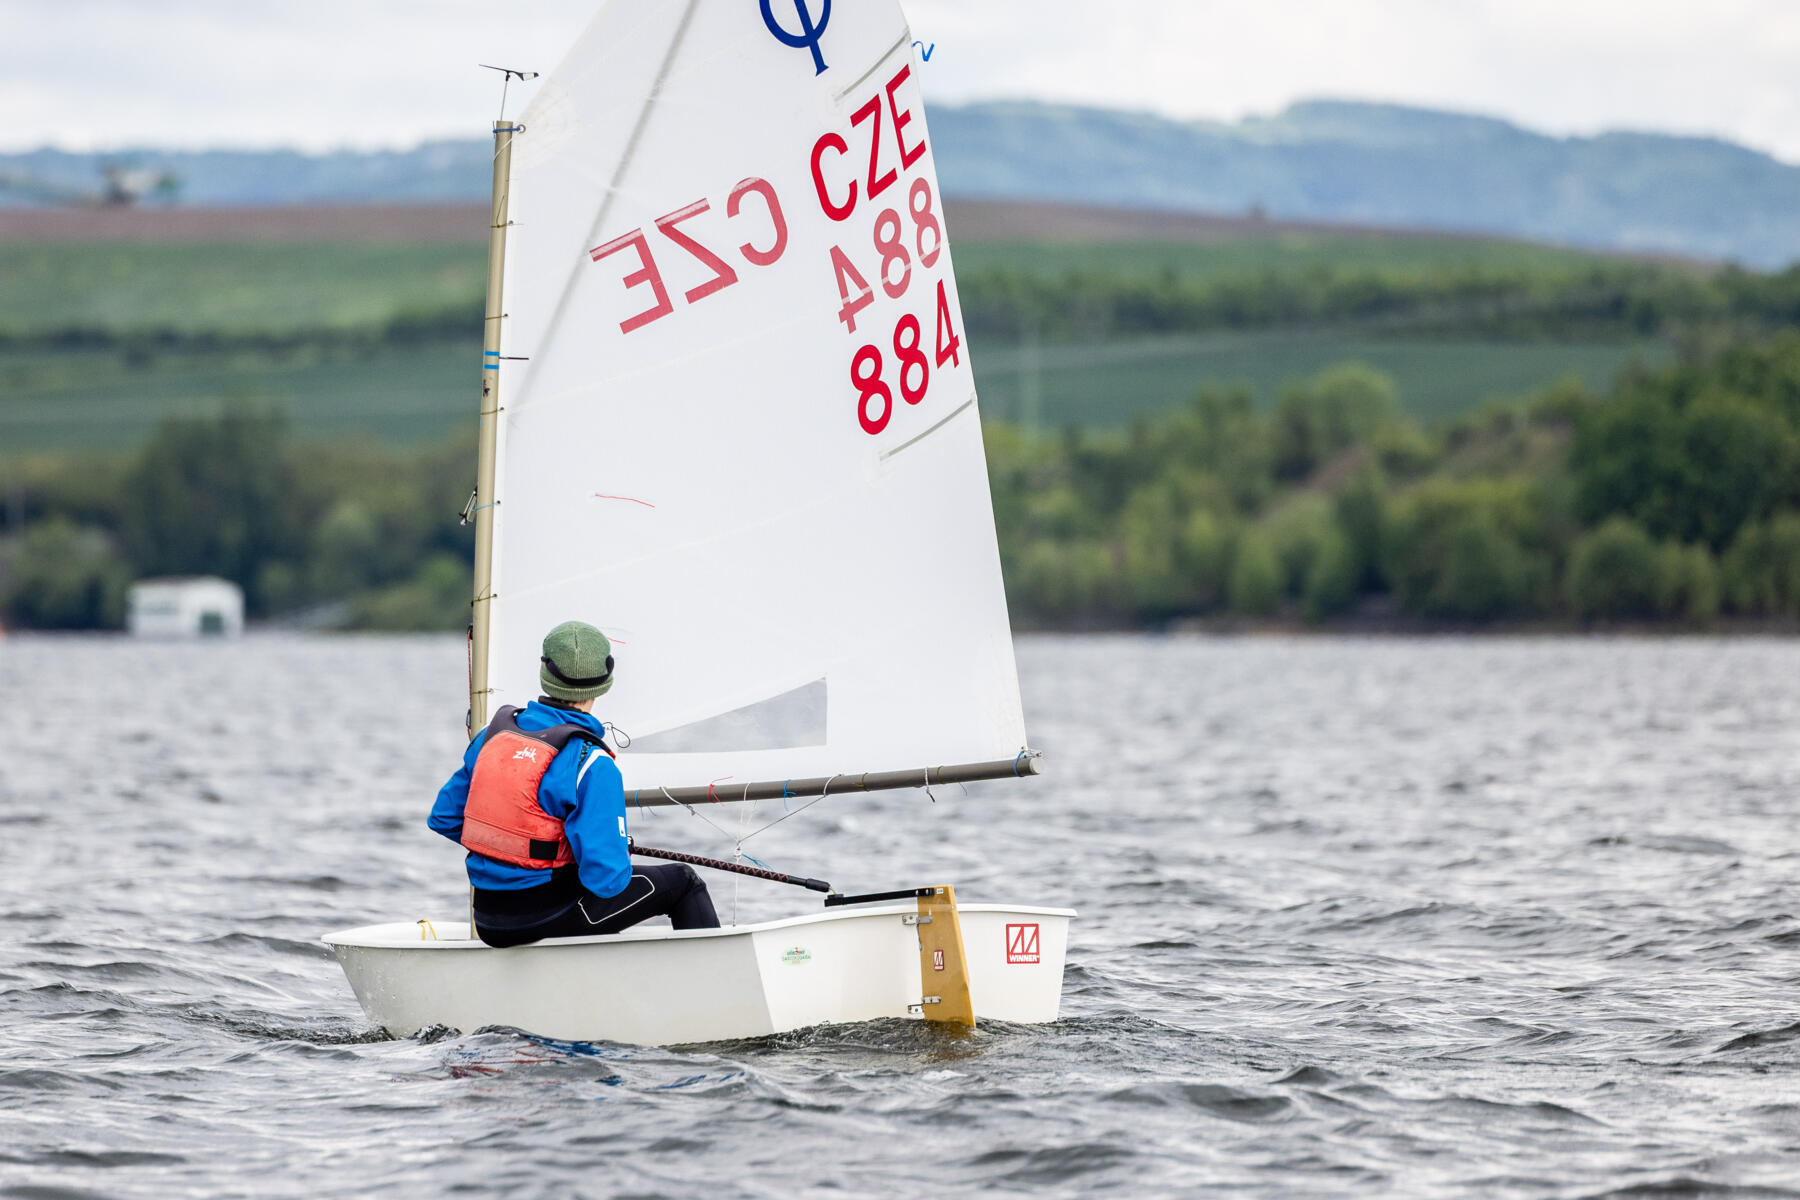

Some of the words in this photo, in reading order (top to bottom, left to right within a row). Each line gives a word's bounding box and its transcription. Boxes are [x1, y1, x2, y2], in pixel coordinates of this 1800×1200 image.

[810, 64, 926, 221] CZE
[850, 279, 960, 435] 884
[1009, 954, 1037, 962] WINNER
